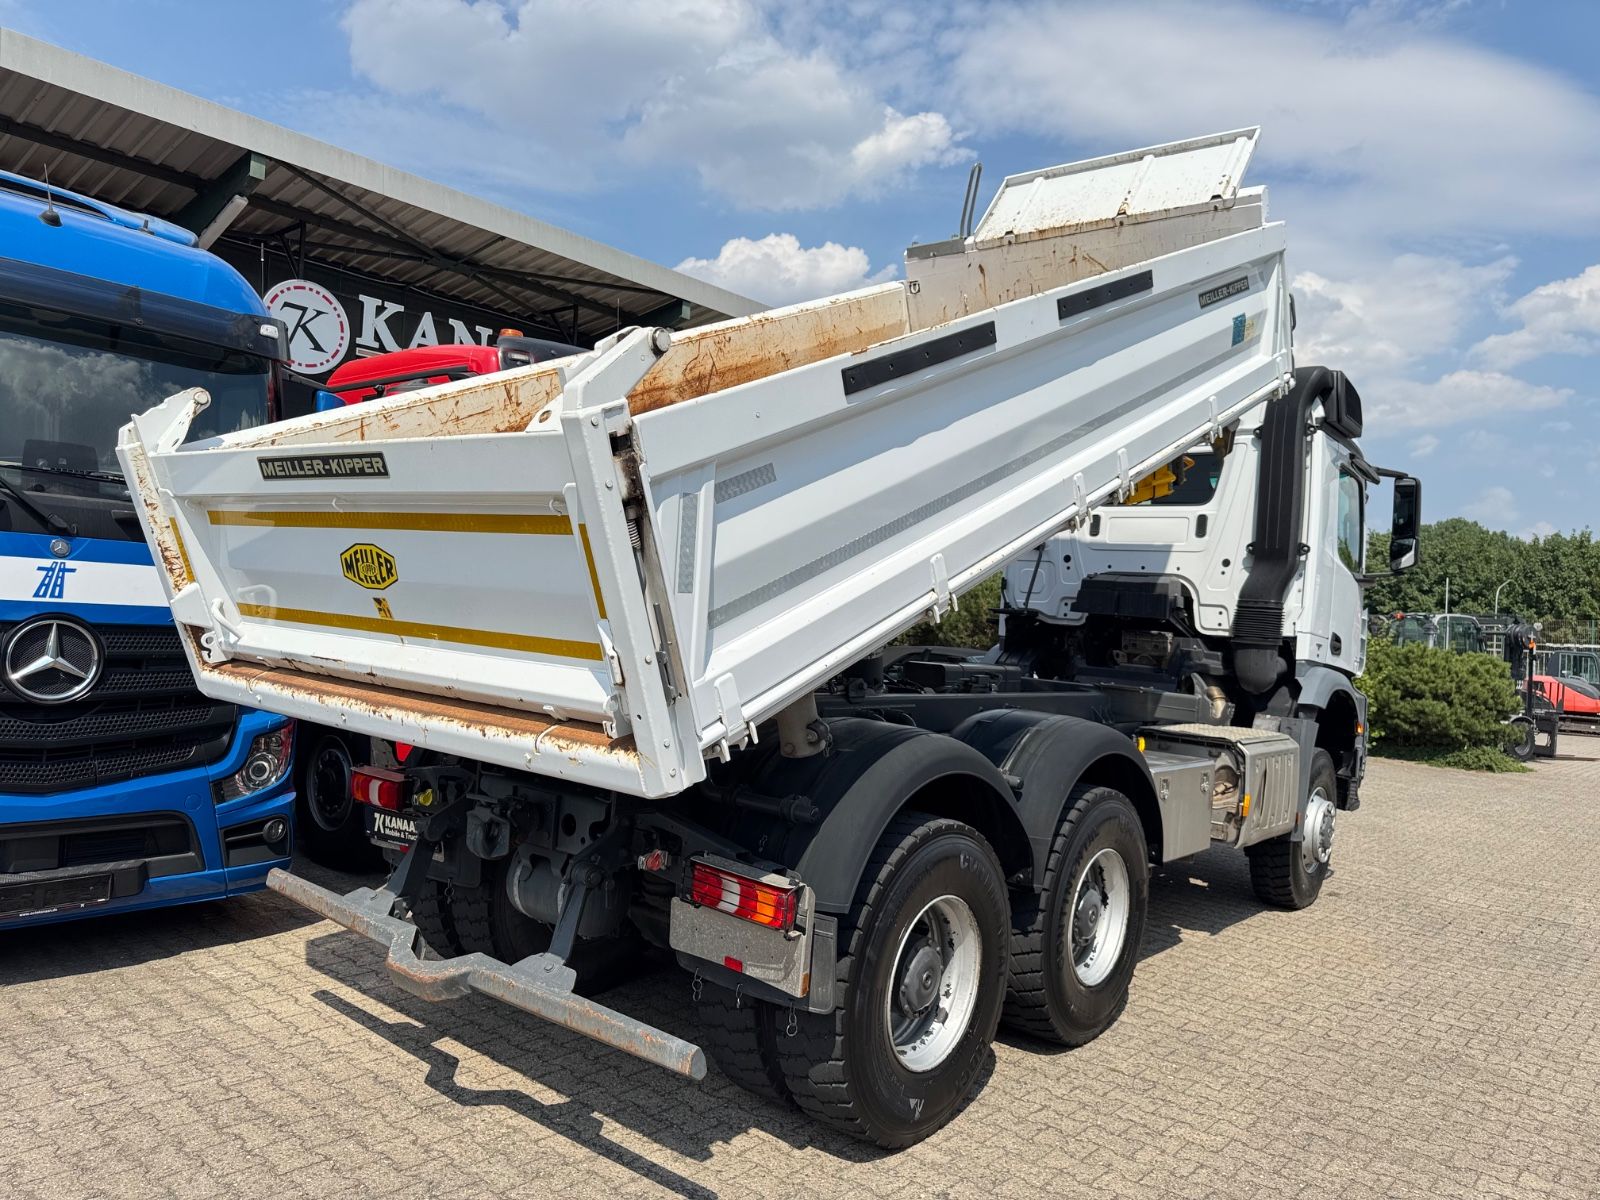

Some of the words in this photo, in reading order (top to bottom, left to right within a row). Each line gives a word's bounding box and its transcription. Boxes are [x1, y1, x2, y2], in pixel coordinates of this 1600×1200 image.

[1200, 279, 1249, 306] MEILLER-KIPPER
[356, 294, 493, 351] KAN
[261, 457, 385, 477] MEILLER-KIPPER
[344, 549, 394, 585] MEILLER
[385, 815, 417, 833] KANAA
